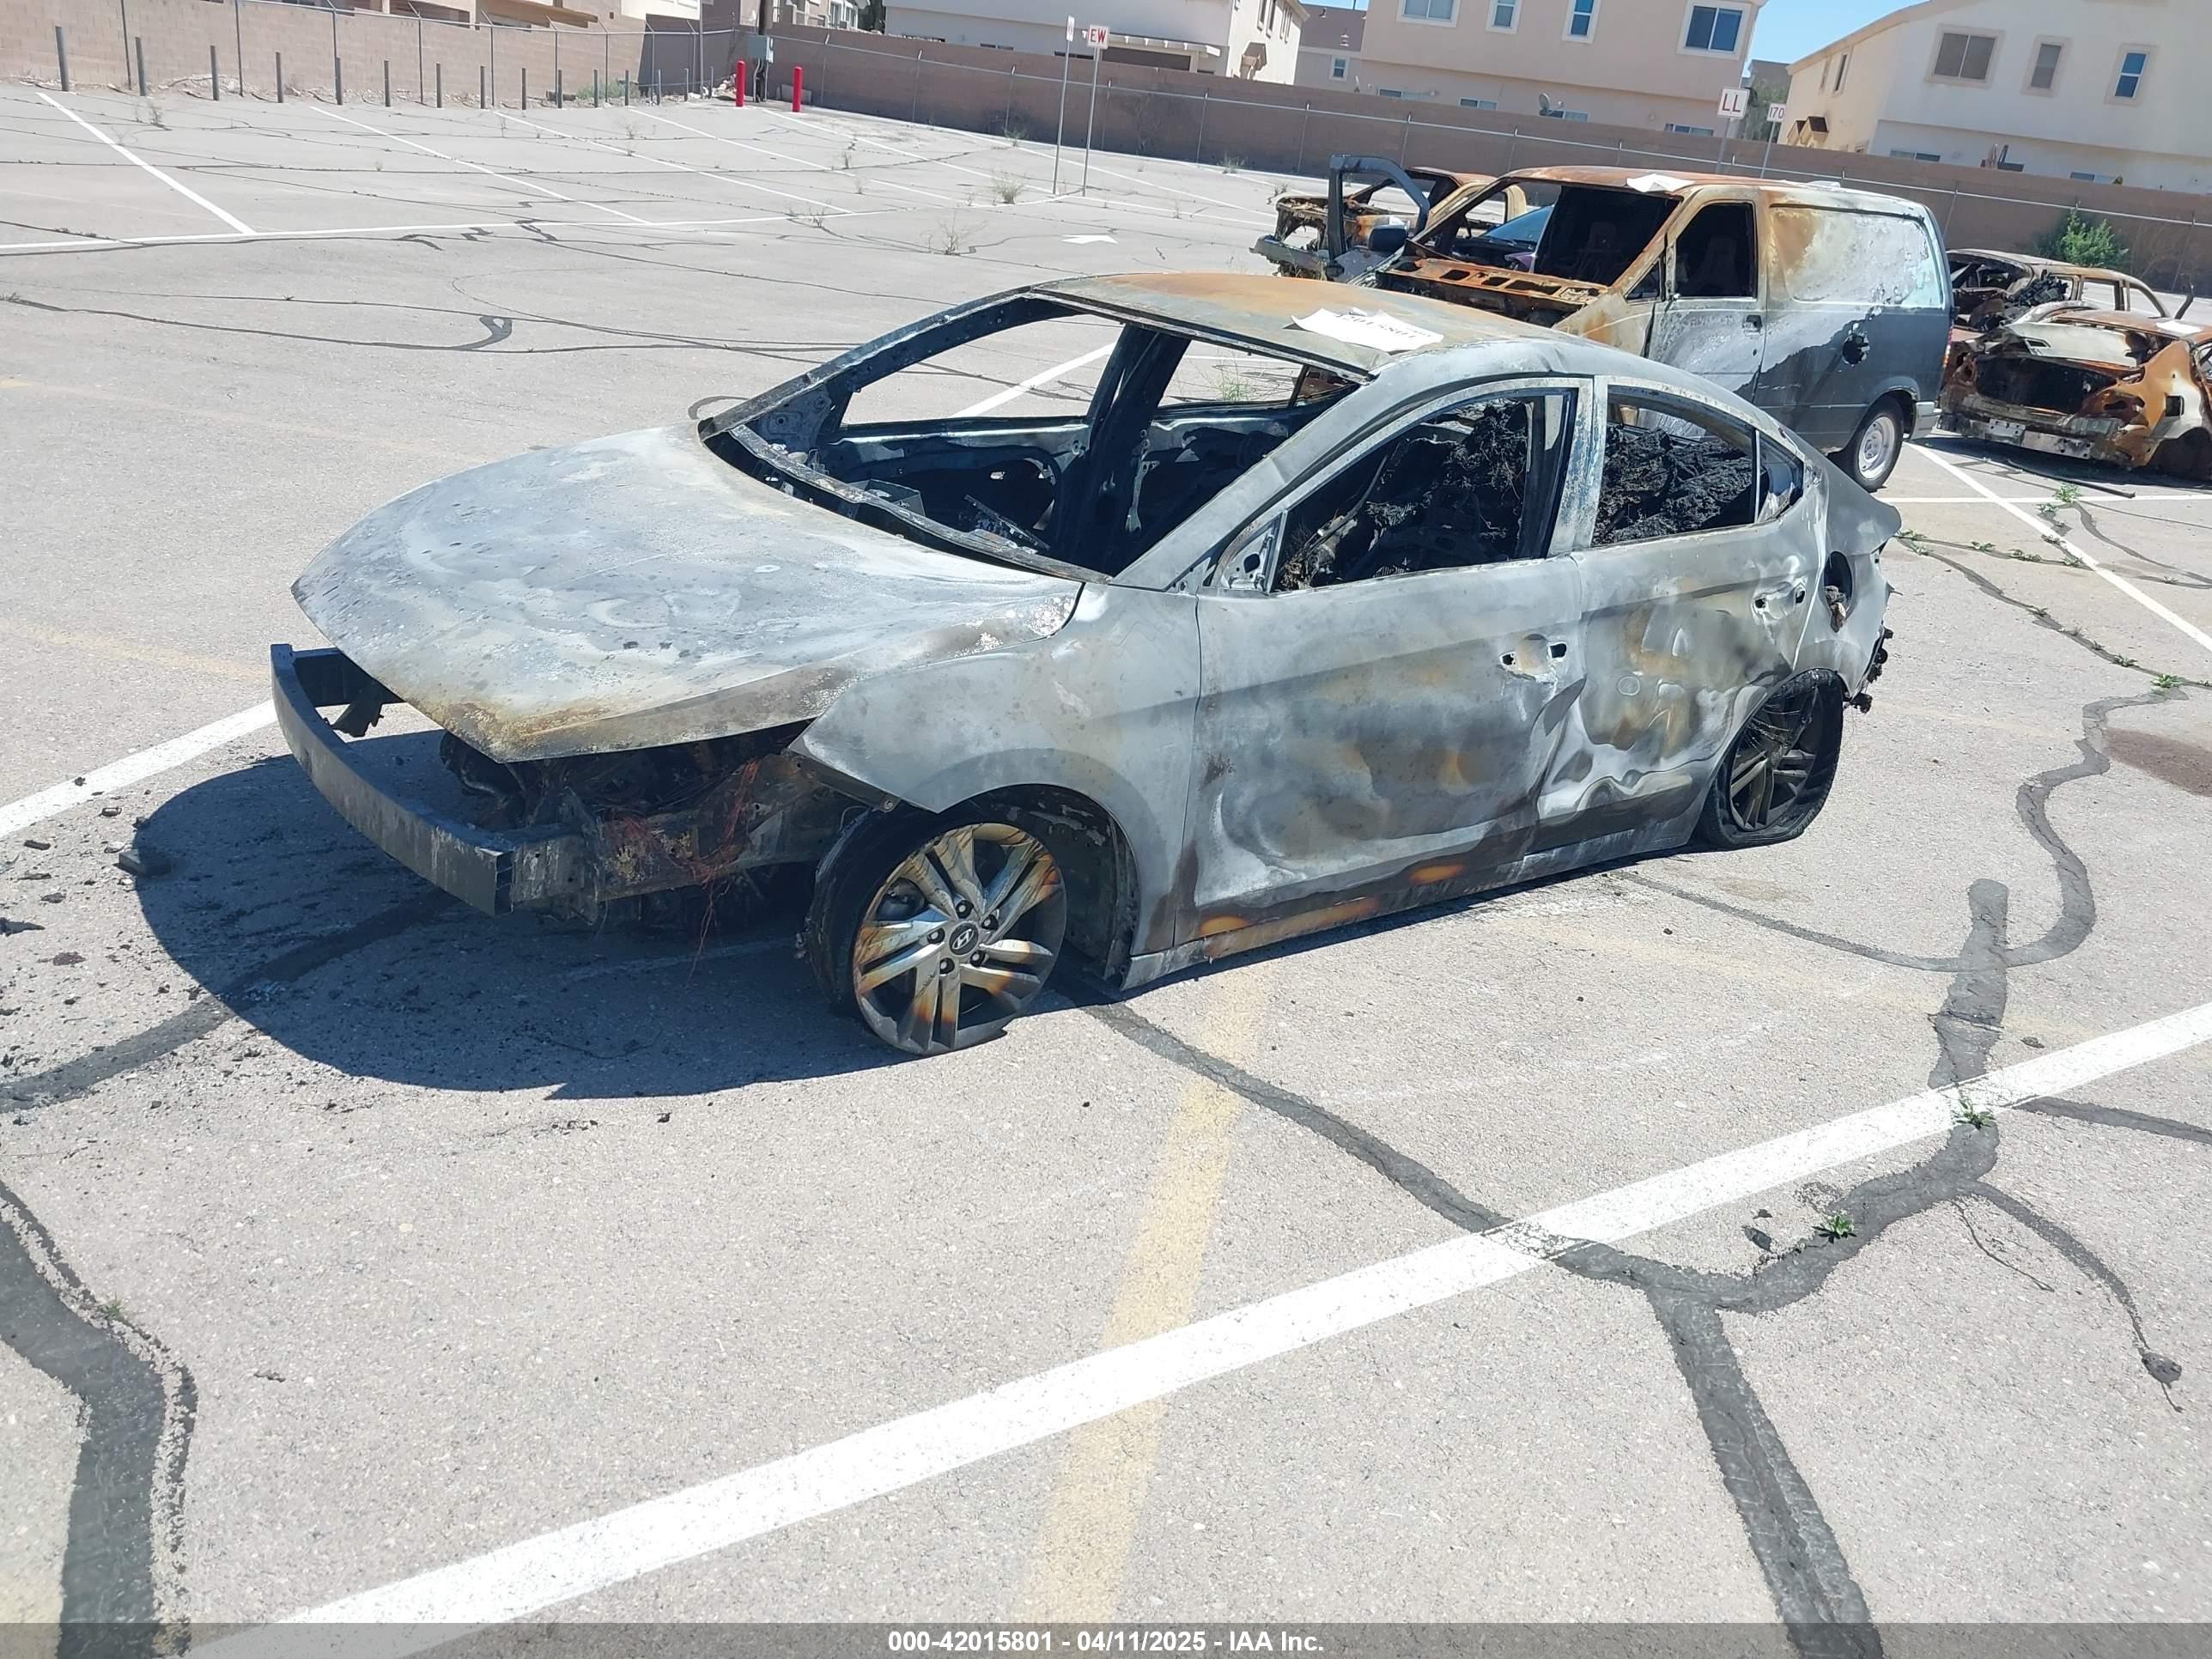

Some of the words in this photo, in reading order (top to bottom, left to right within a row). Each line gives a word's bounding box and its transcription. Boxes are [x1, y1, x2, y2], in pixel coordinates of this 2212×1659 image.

[1090, 28, 1106, 42] EW
[1722, 93, 1741, 112] LL
[1769, 106, 1784, 118] 170
